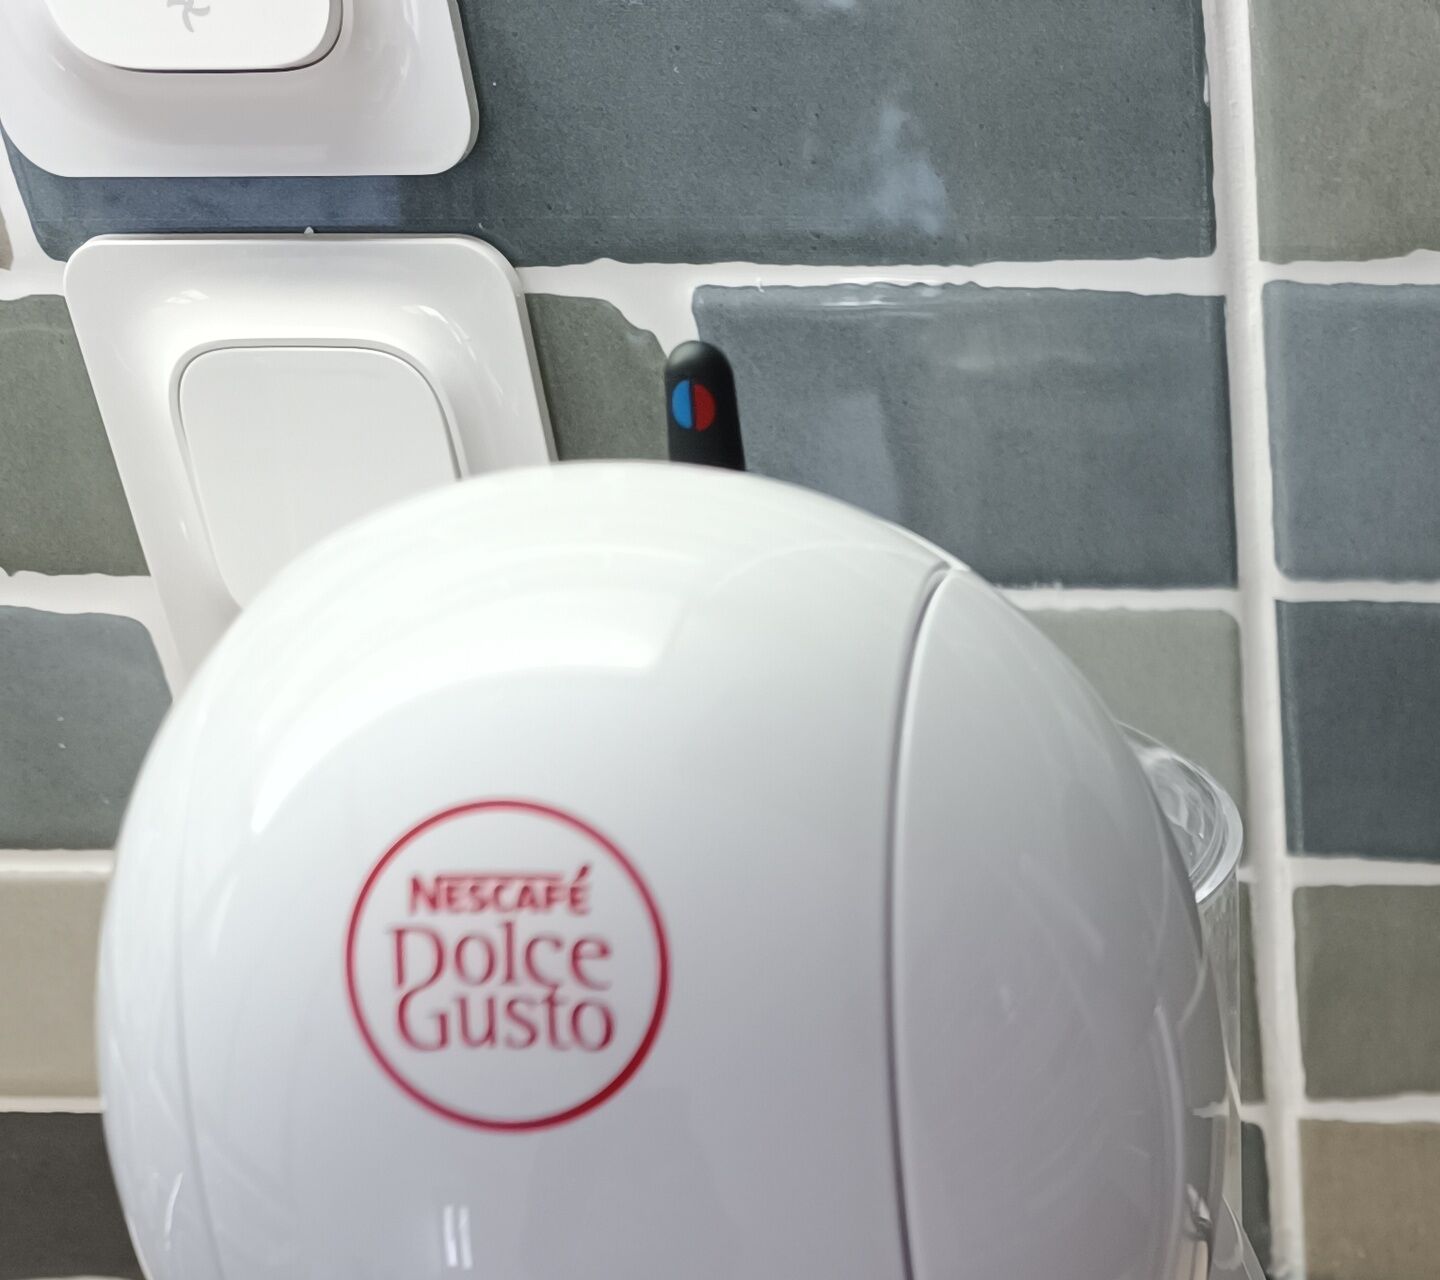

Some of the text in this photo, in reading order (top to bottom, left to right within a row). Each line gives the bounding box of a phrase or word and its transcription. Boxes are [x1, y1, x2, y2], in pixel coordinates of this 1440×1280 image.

[408, 864, 591, 915] NESCAFÉ
[390, 920, 612, 991] Dolce
[397, 985, 615, 1051] Gusto
